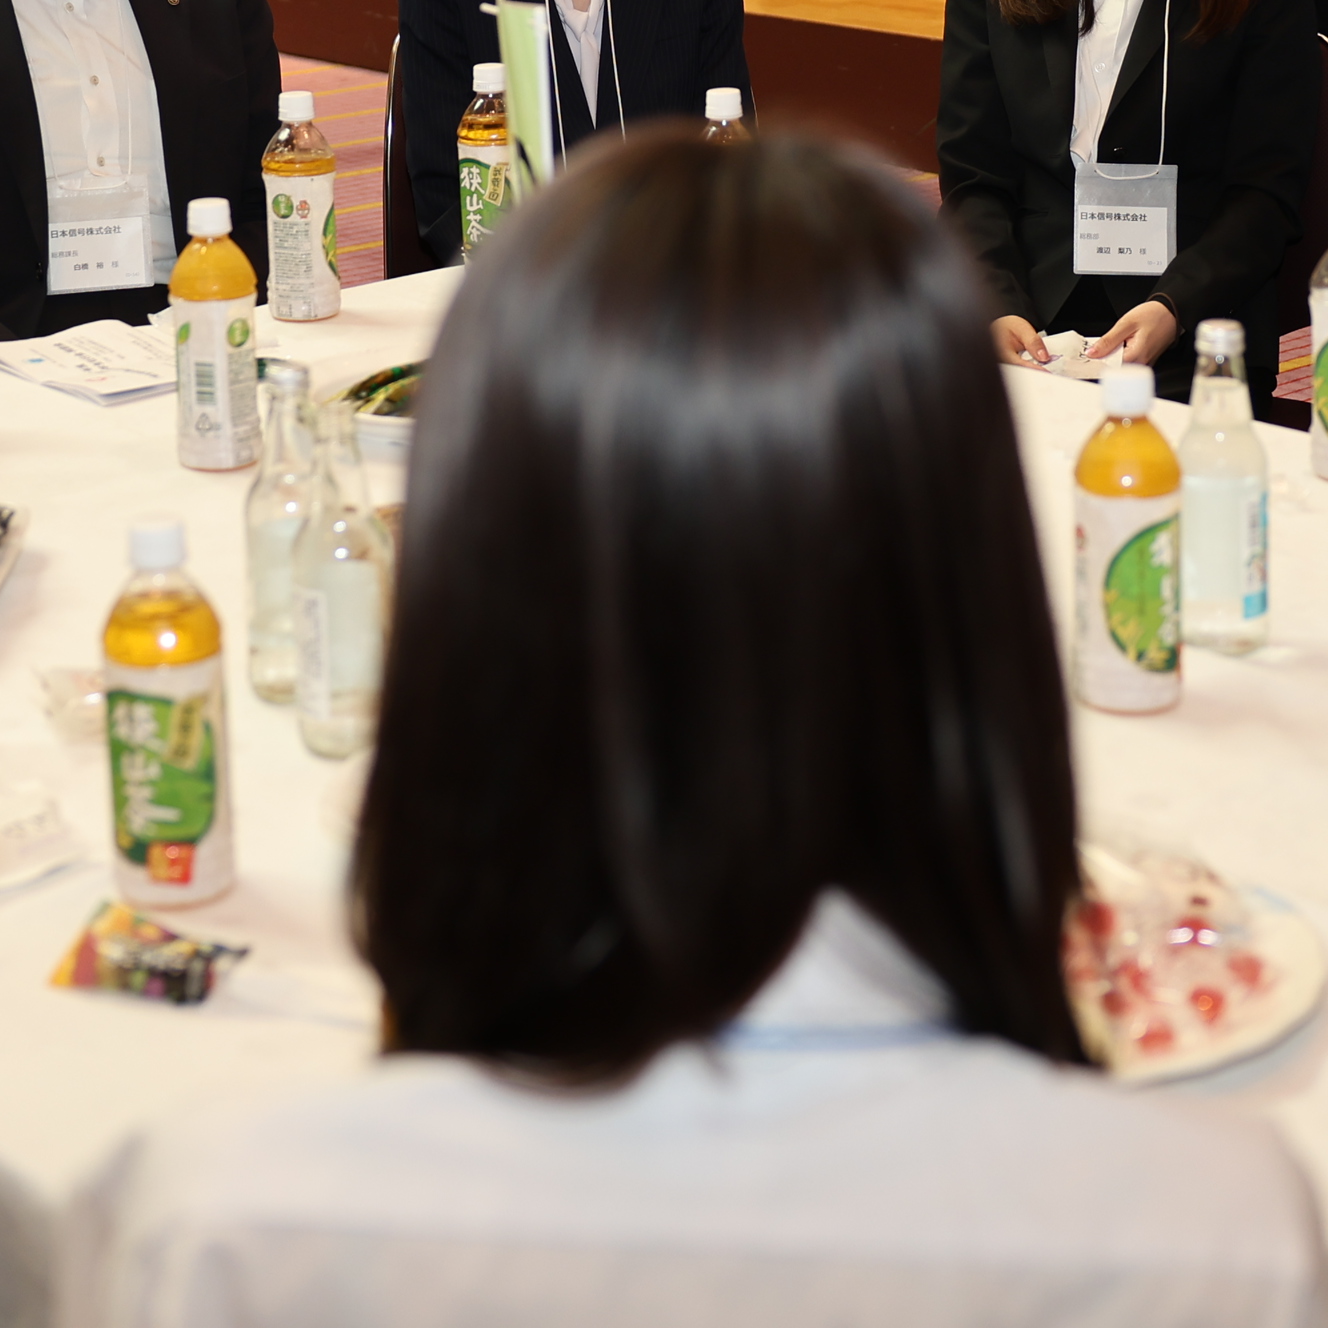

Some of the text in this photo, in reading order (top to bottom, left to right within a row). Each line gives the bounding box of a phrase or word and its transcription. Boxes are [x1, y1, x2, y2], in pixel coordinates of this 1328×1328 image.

[1080, 211, 1148, 222] 日本信号株式会社
[50, 224, 123, 239] 日本信号株式会社
